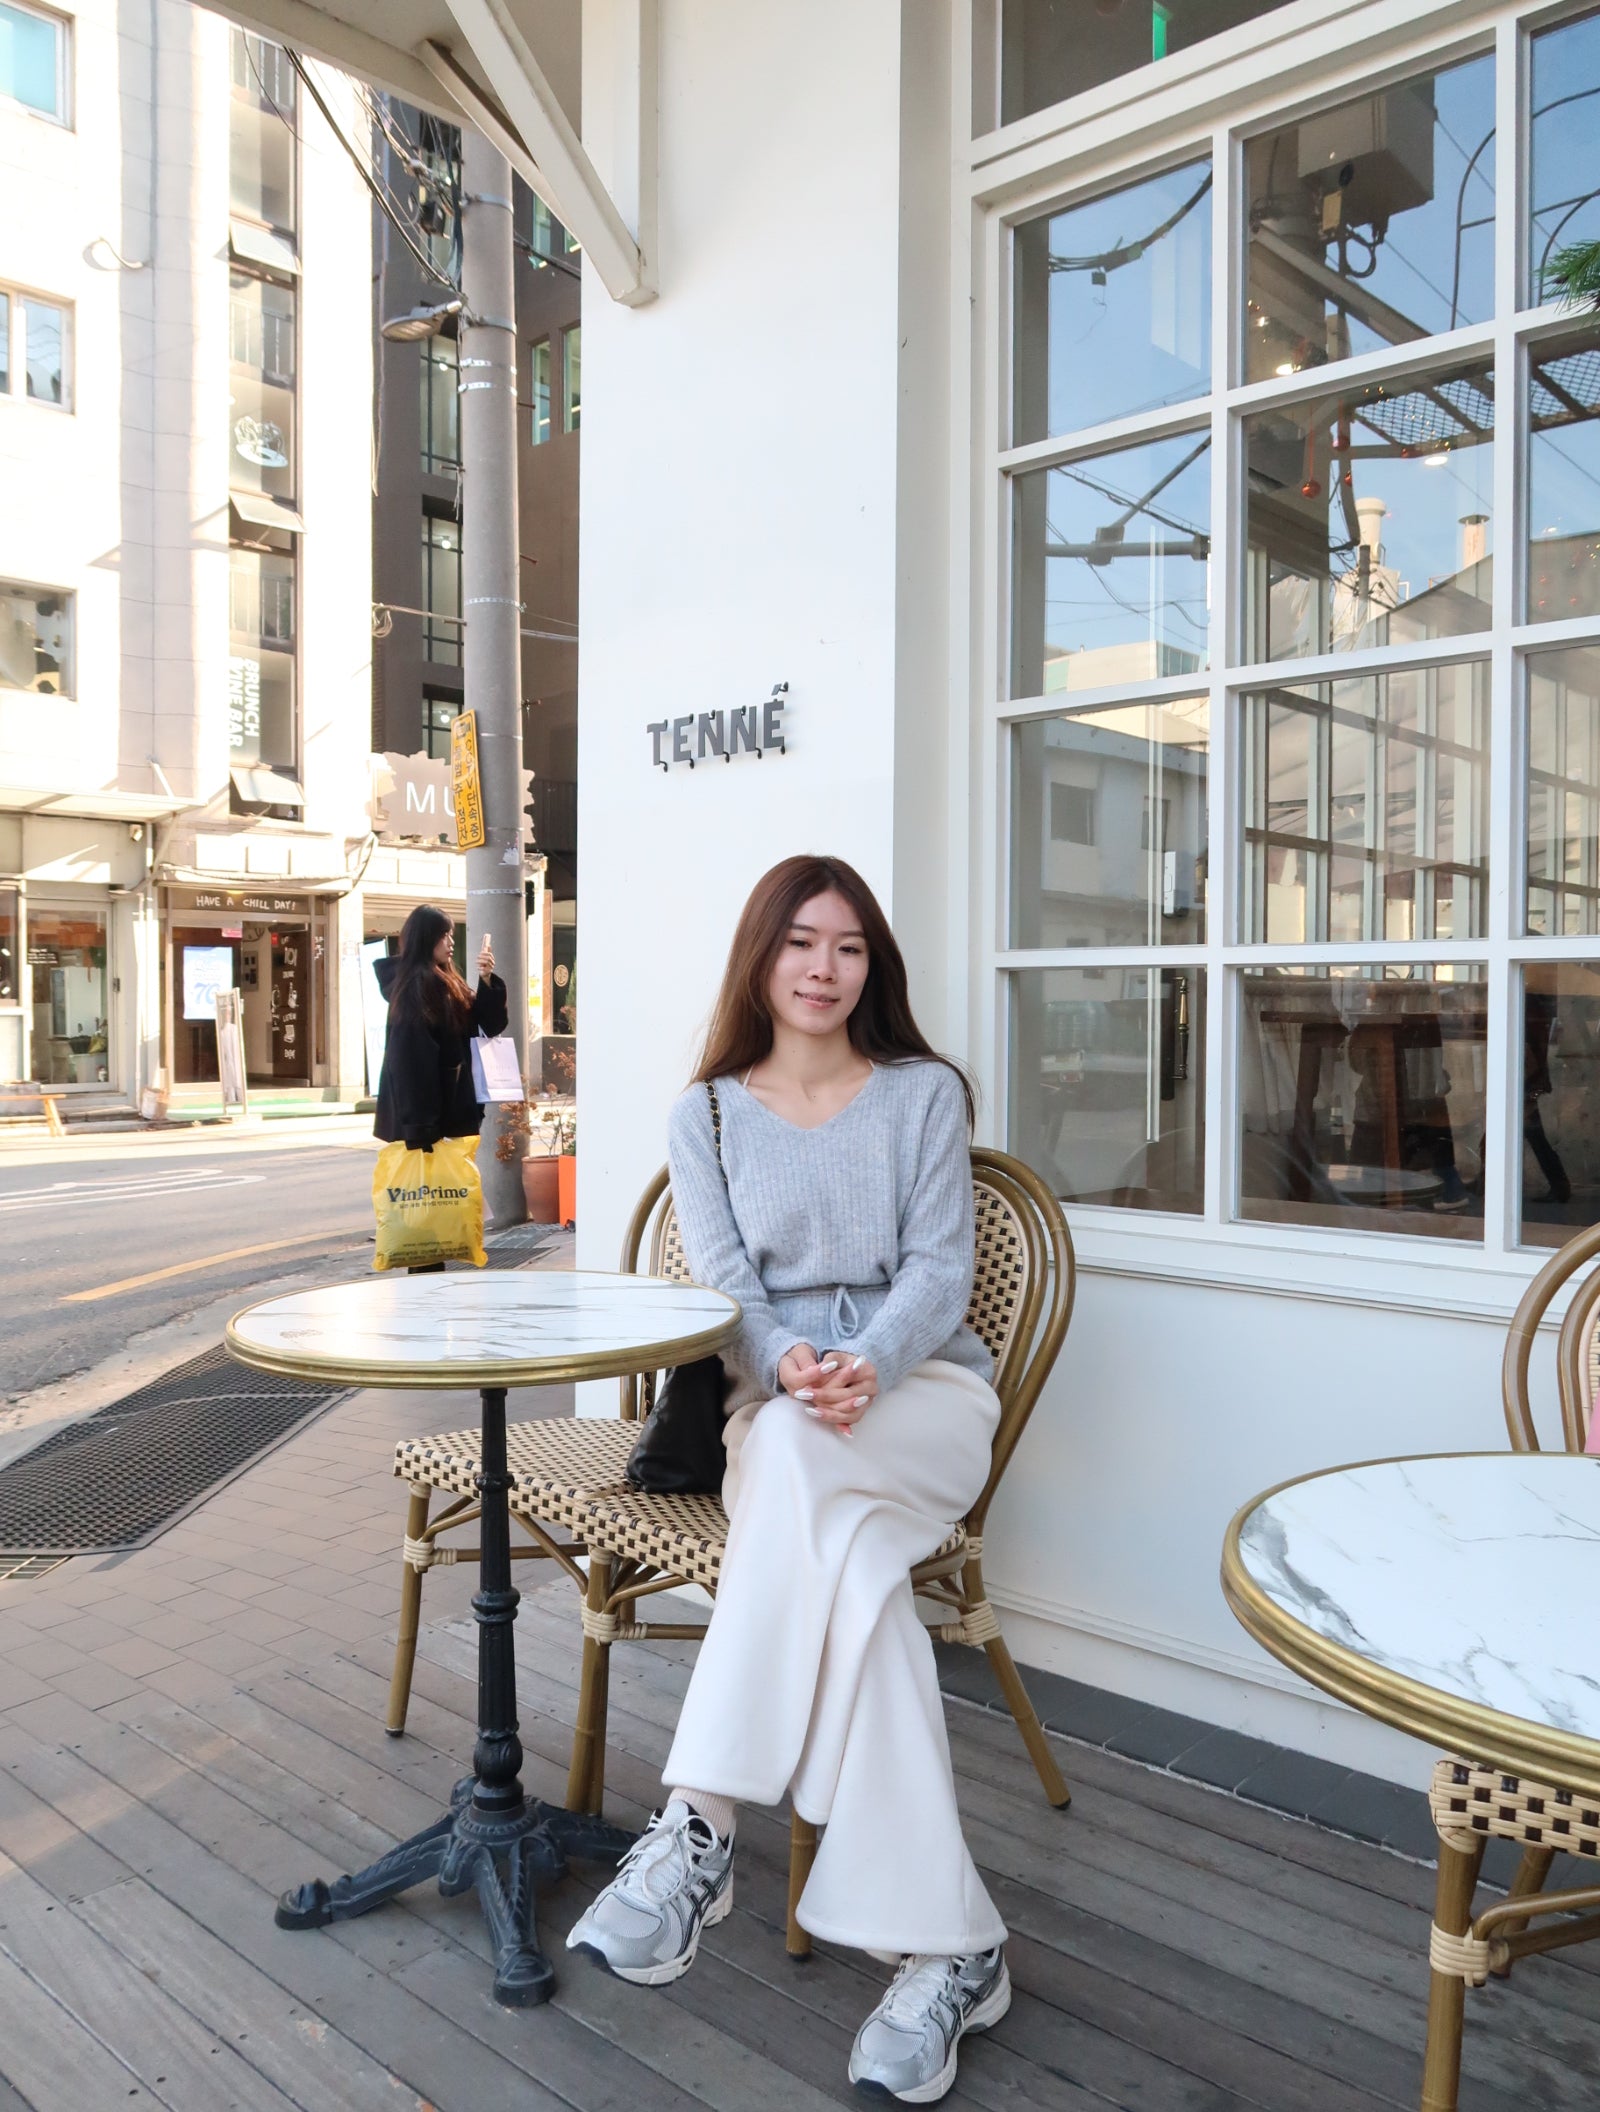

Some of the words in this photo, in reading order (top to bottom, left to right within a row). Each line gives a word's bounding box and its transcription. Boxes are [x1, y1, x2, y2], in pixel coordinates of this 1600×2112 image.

[245, 658, 260, 737] BRUNCH
[228, 707, 244, 747] BAR
[647, 683, 786, 766] TENNÉ
[196, 895, 221, 907] HAVE
[226, 897, 234, 906] A
[242, 898, 270, 910] CHILL
[274, 900, 296, 910] DAY!
[387, 1185, 468, 1202] VinPrime
